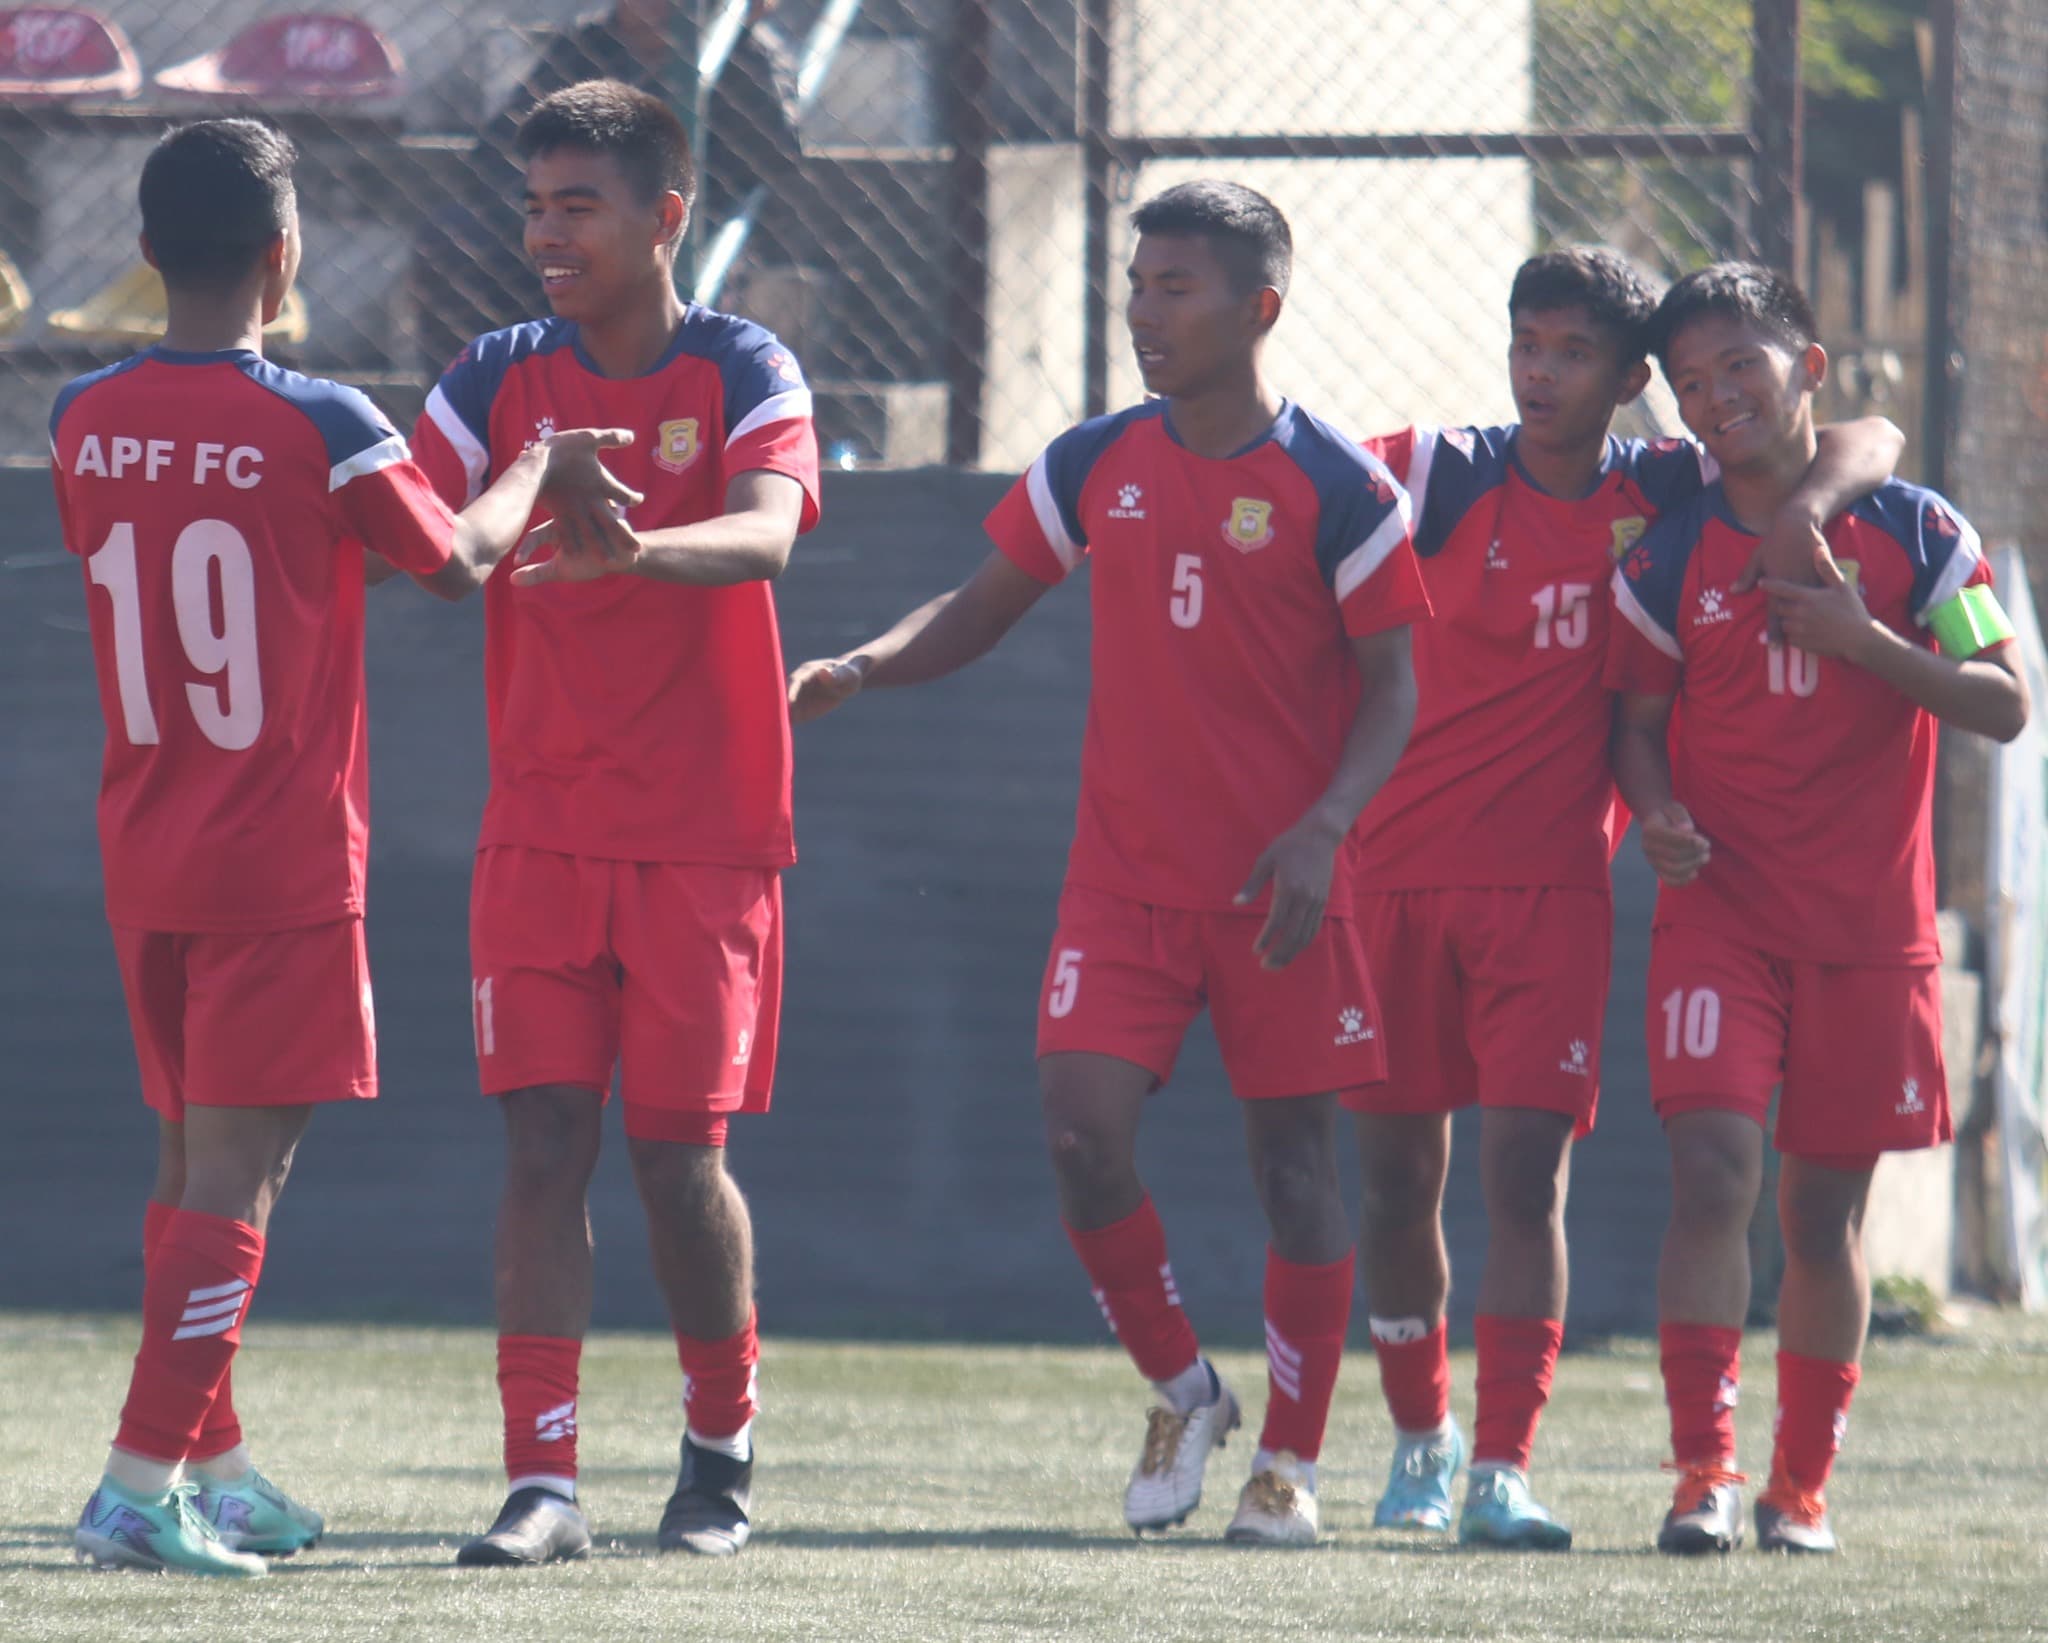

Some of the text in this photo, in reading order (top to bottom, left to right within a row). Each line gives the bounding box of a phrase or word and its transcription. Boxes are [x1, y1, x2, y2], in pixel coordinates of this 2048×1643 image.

[74, 434, 264, 489] APF FC
[1108, 508, 1146, 519] KELME
[1169, 552, 1203, 629] 5
[1531, 583, 1592, 649] 15
[1693, 610, 1733, 626] KELME
[88, 518, 264, 751] 19
[1758, 631, 1819, 698] 10
[472, 976, 495, 1056] 1
[1048, 949, 1083, 1018] 5
[1334, 1029, 1375, 1046] KELME
[1661, 986, 1720, 1060] 10
